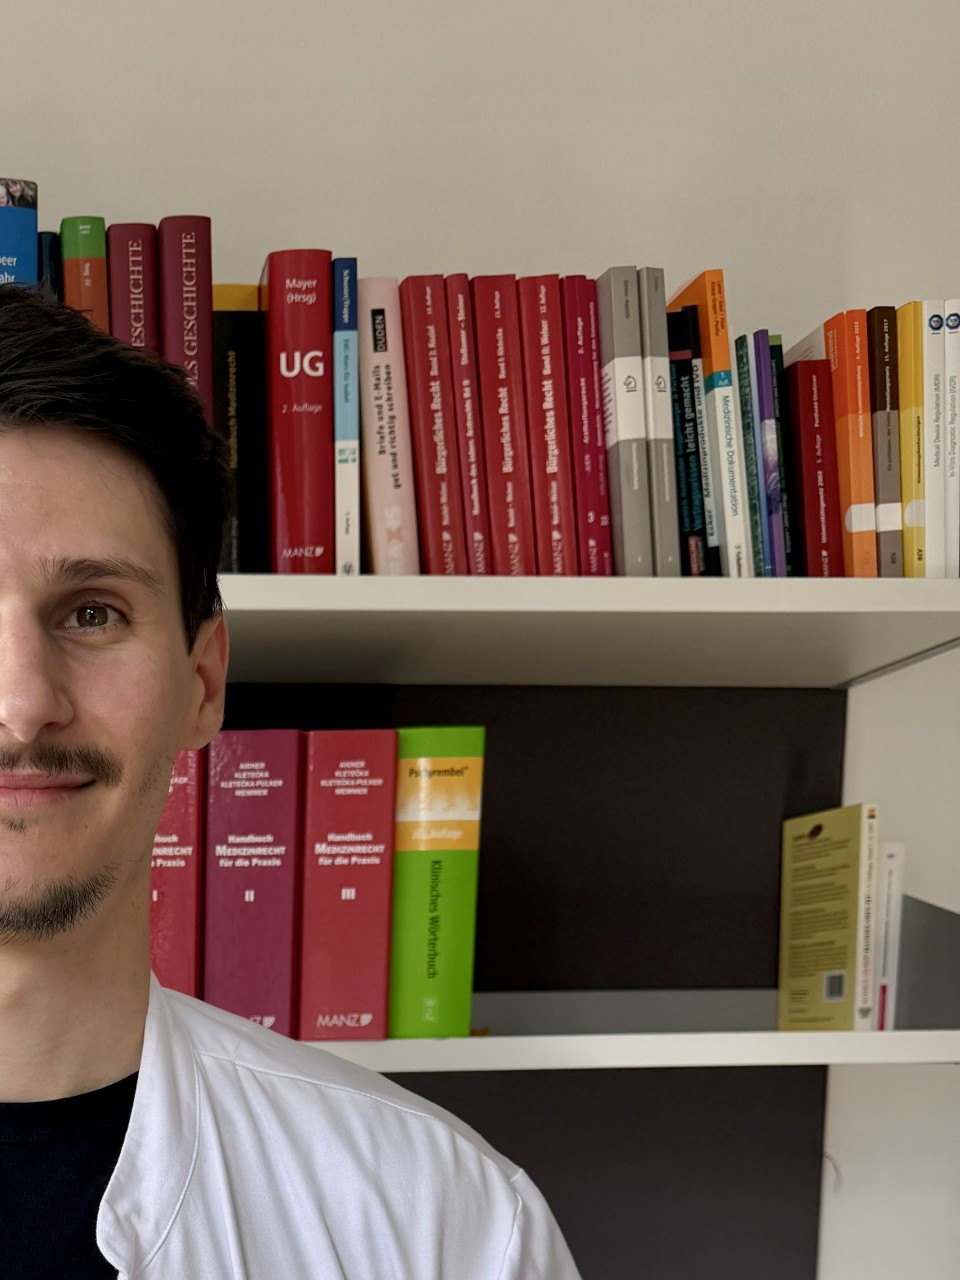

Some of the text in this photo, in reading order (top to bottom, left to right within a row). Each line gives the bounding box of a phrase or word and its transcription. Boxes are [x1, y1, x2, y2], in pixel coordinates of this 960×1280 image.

[128, 240, 145, 348] ESCHICHTE
[182, 232, 198, 356] GESCHICHTE
[285, 278, 317, 293] Mayer
[374, 315, 386, 351] DUDEN
[576, 316, 584, 345] Auflage
[279, 350, 325, 379] UG
[291, 402, 322, 416] Auflage
[372, 364, 387, 456] Briefe und E-Mails
[540, 319, 560, 474] Bürgerliches Recht Band Welser
[680, 375, 695, 420] gemacht
[694, 385, 702, 406] und
[933, 393, 941, 423] Regulation
[948, 394, 957, 425] Regulation
[384, 364, 402, 490] gut und richtig schreiben
[430, 381, 447, 474] Bürgerliches Recht
[498, 387, 514, 474] Bürgerliches Recht
[683, 421, 696, 453] leicht
[949, 427, 957, 455] Diagnostic
[696, 408, 711, 498] Medizinprodukte
[722, 395, 739, 517] Medizinische Dokumentation
[282, 547, 315, 559] MANZ
[227, 835, 274, 844] Handbuch
[327, 832, 373, 842] Handbuch
[156, 859, 186, 867] Praxis
[219, 858, 282, 868] für die Praxis
[318, 855, 381, 866] für die Praxis
[244, 889, 255, 902] II
[341, 888, 356, 900] III
[426, 860, 443, 980] Klinisches Wörterbuch
[317, 1014, 360, 1027] MANZ
